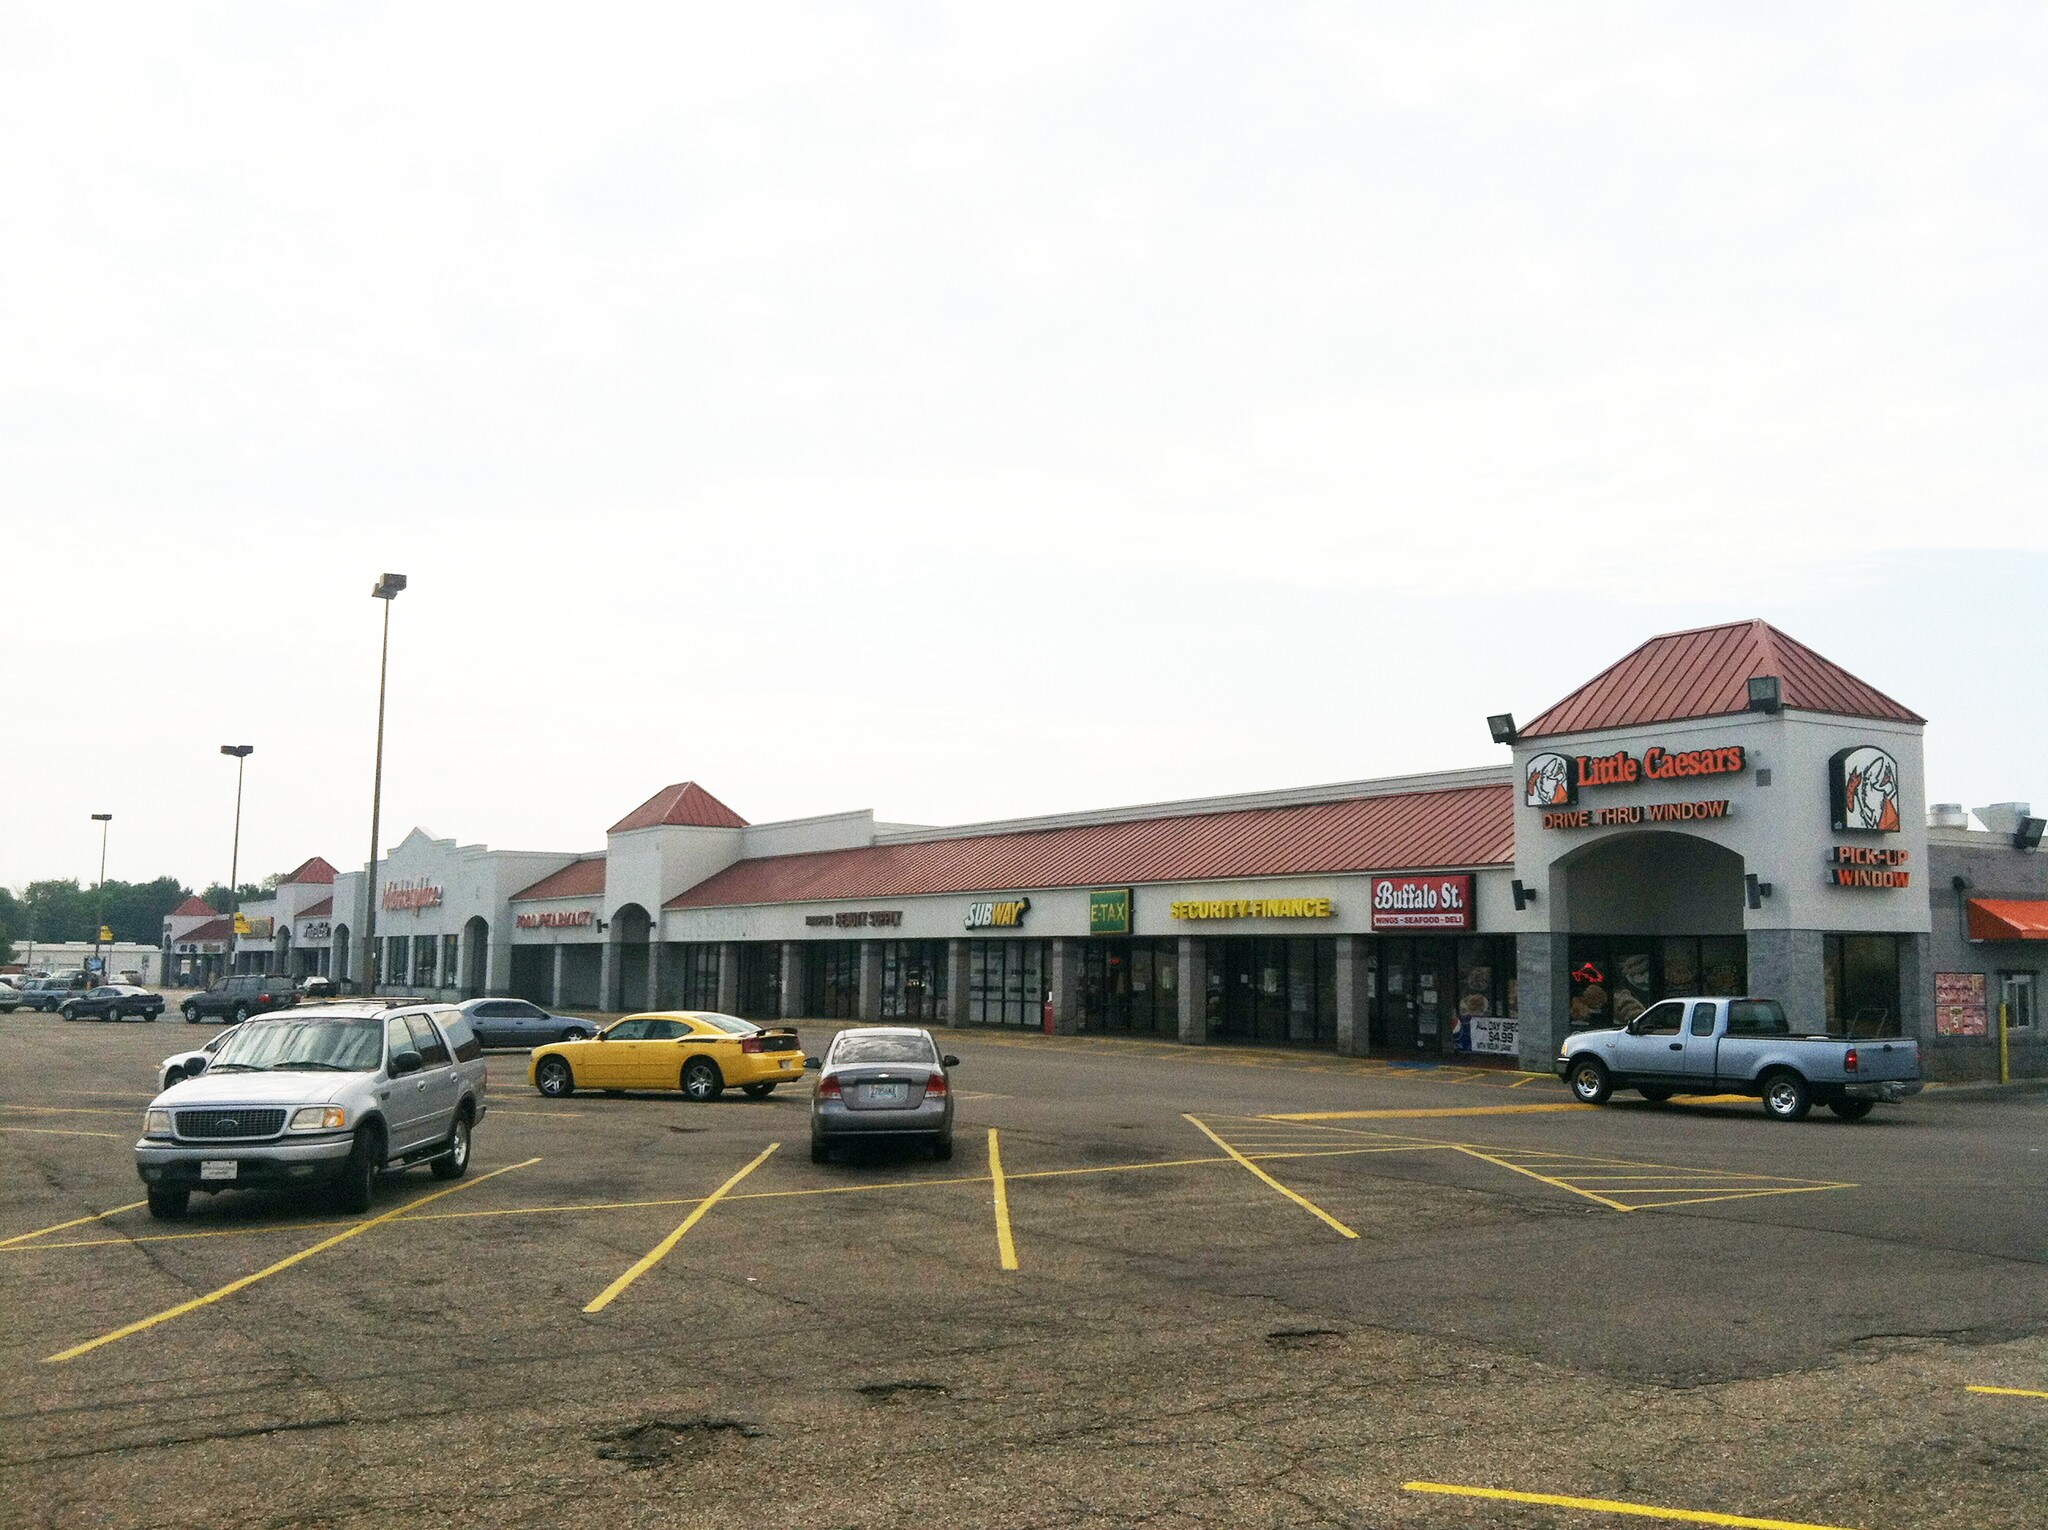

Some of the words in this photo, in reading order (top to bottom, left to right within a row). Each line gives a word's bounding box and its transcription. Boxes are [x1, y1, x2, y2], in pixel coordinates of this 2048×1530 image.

[1576, 752, 1638, 787] Little
[1644, 746, 1743, 779] Caesars
[1543, 811, 1590, 830] DRIVE
[1597, 807, 1641, 826] THRU
[1650, 801, 1729, 821] WINDOW
[1839, 846, 1909, 866] PICK-UP
[1838, 868, 1911, 888] WINDOW
[1375, 881, 1438, 909] Buffalo
[1441, 882, 1463, 908] St.
[964, 901, 1028, 928] SUBWAY
[1170, 901, 1250, 919] SECURITY
[1252, 899, 1331, 918] FINANCE
[1376, 916, 1399, 924] WINGS
[1404, 916, 1439, 924] SEAFOOD
[1445, 915, 1463, 924] DELI
[1476, 1021, 1488, 1031] ALL
[1489, 1021, 1501, 1031] DAY
[1488, 1031, 1514, 1043] $4.99
